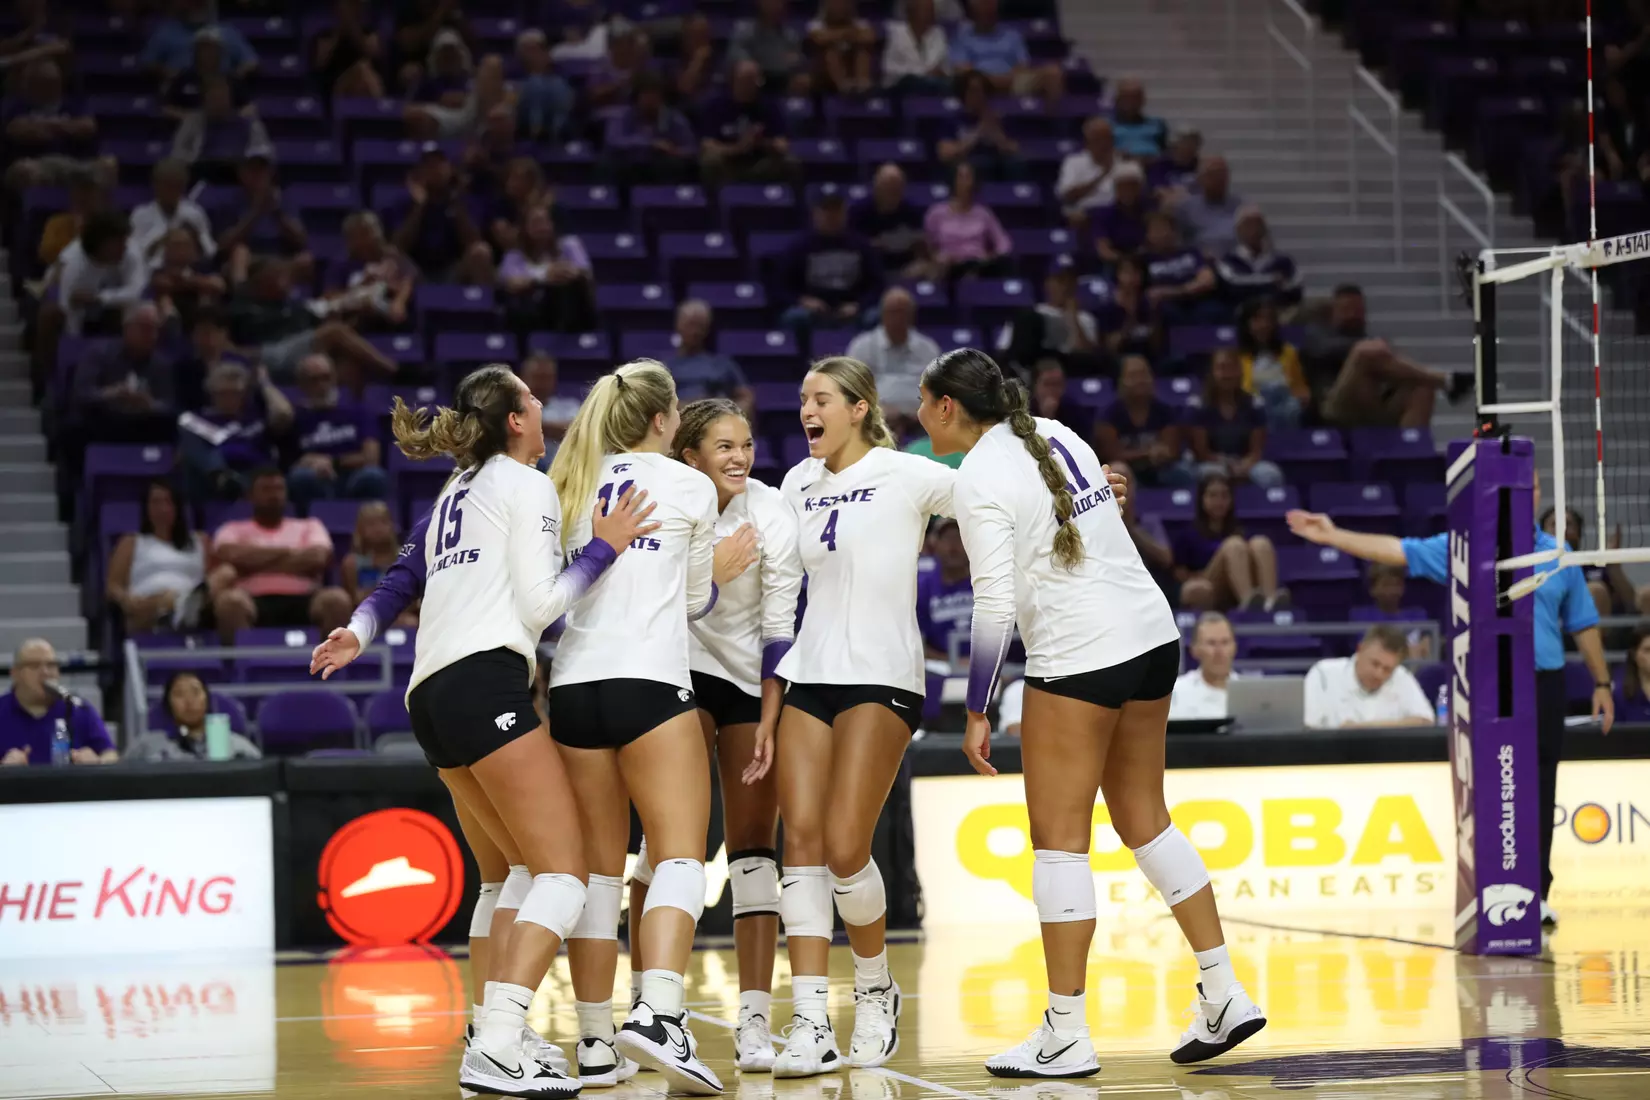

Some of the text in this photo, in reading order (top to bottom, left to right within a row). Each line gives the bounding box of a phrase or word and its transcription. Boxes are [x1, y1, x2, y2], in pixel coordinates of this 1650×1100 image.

[434, 488, 470, 556] 15
[804, 487, 876, 511] K-STATE
[820, 509, 838, 551] 4
[1450, 529, 1475, 872] K-STATE
[1498, 744, 1517, 800] sports
[1318, 872, 1436, 897] EATS
